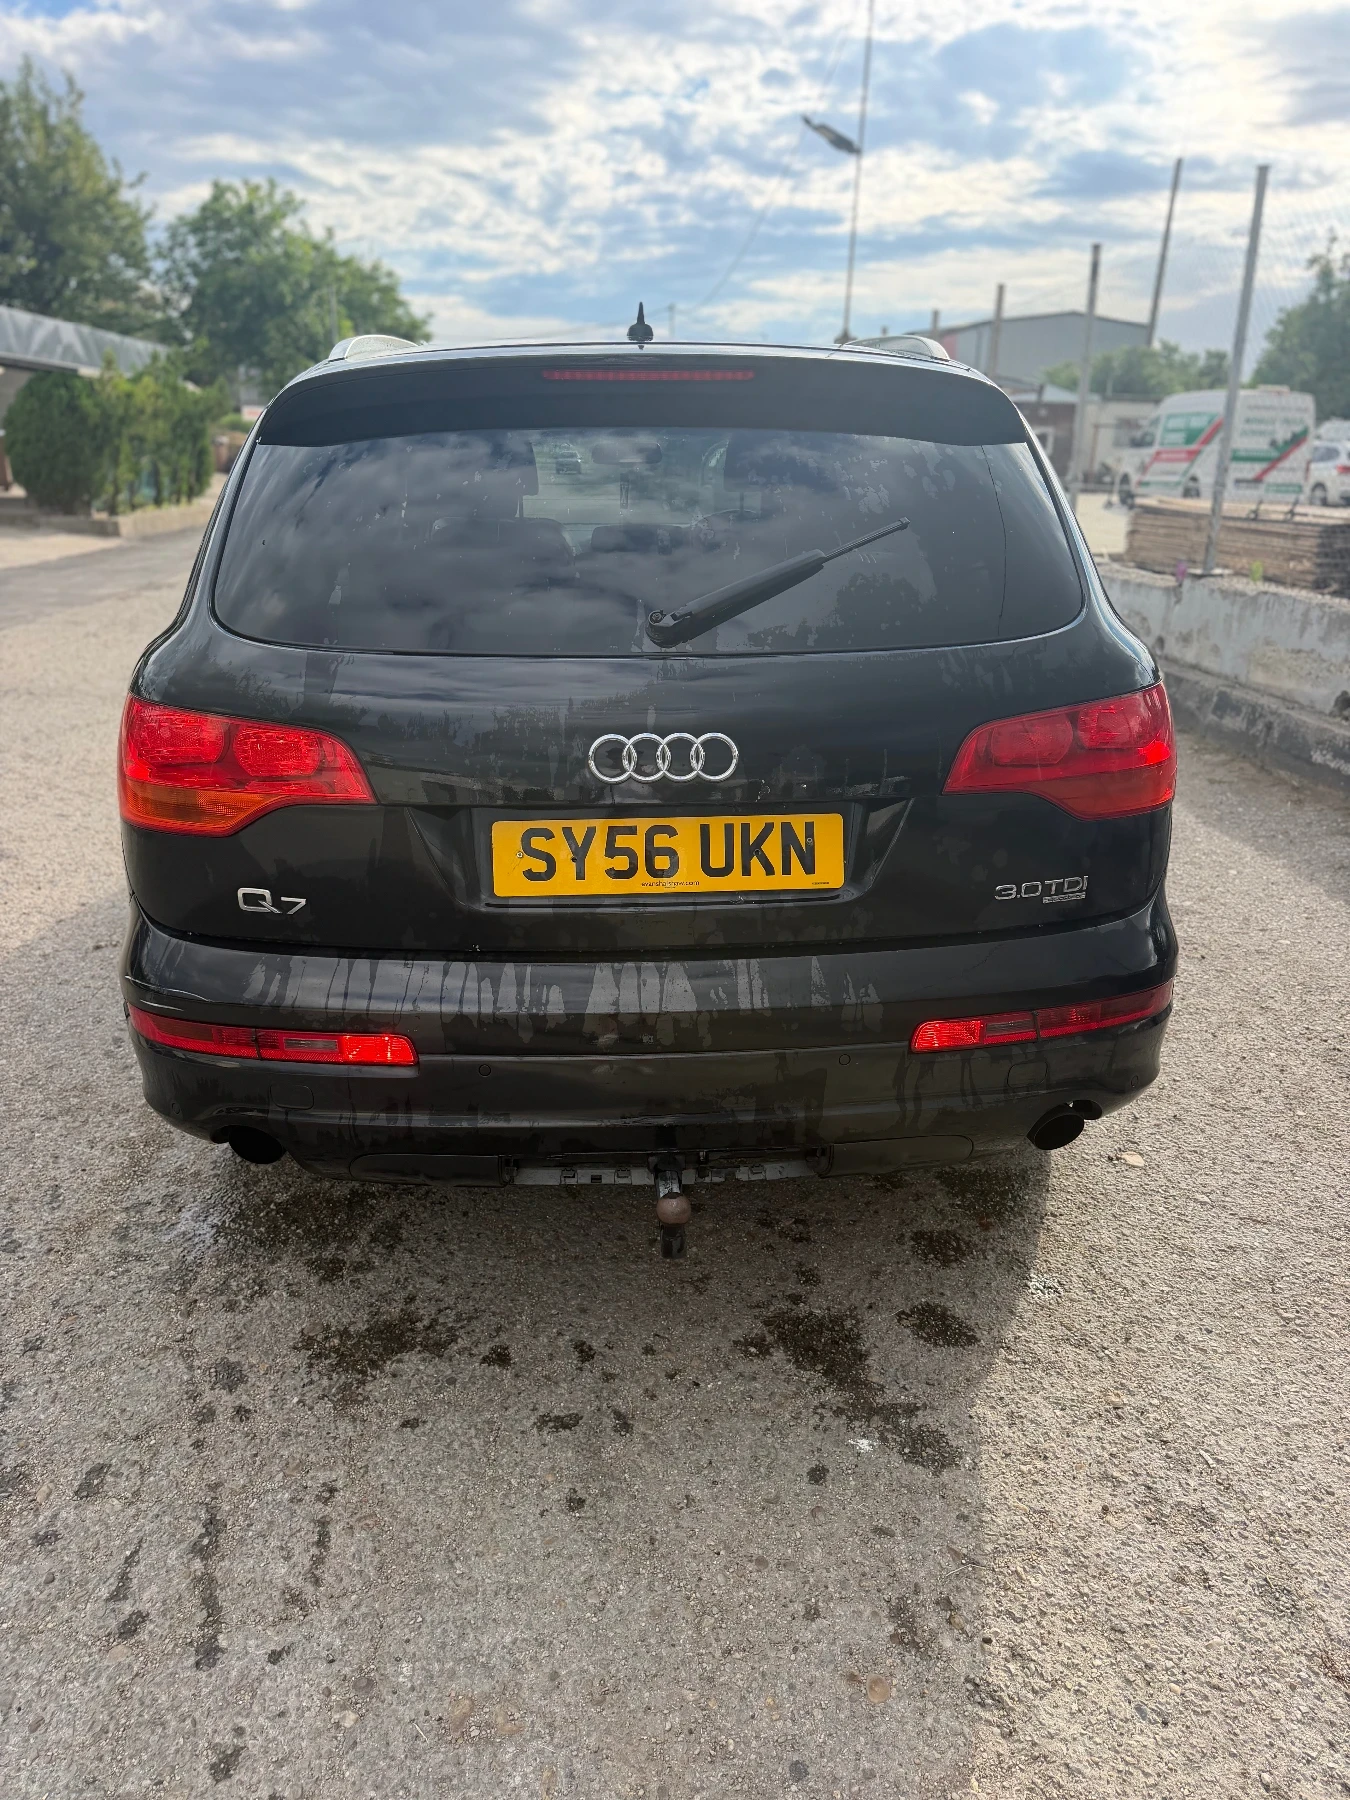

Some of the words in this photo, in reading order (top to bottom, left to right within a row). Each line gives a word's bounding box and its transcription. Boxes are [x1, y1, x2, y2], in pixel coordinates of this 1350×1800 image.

[521, 824, 679, 882] SY56
[700, 821, 816, 878] UKN
[237, 887, 307, 915] Q7
